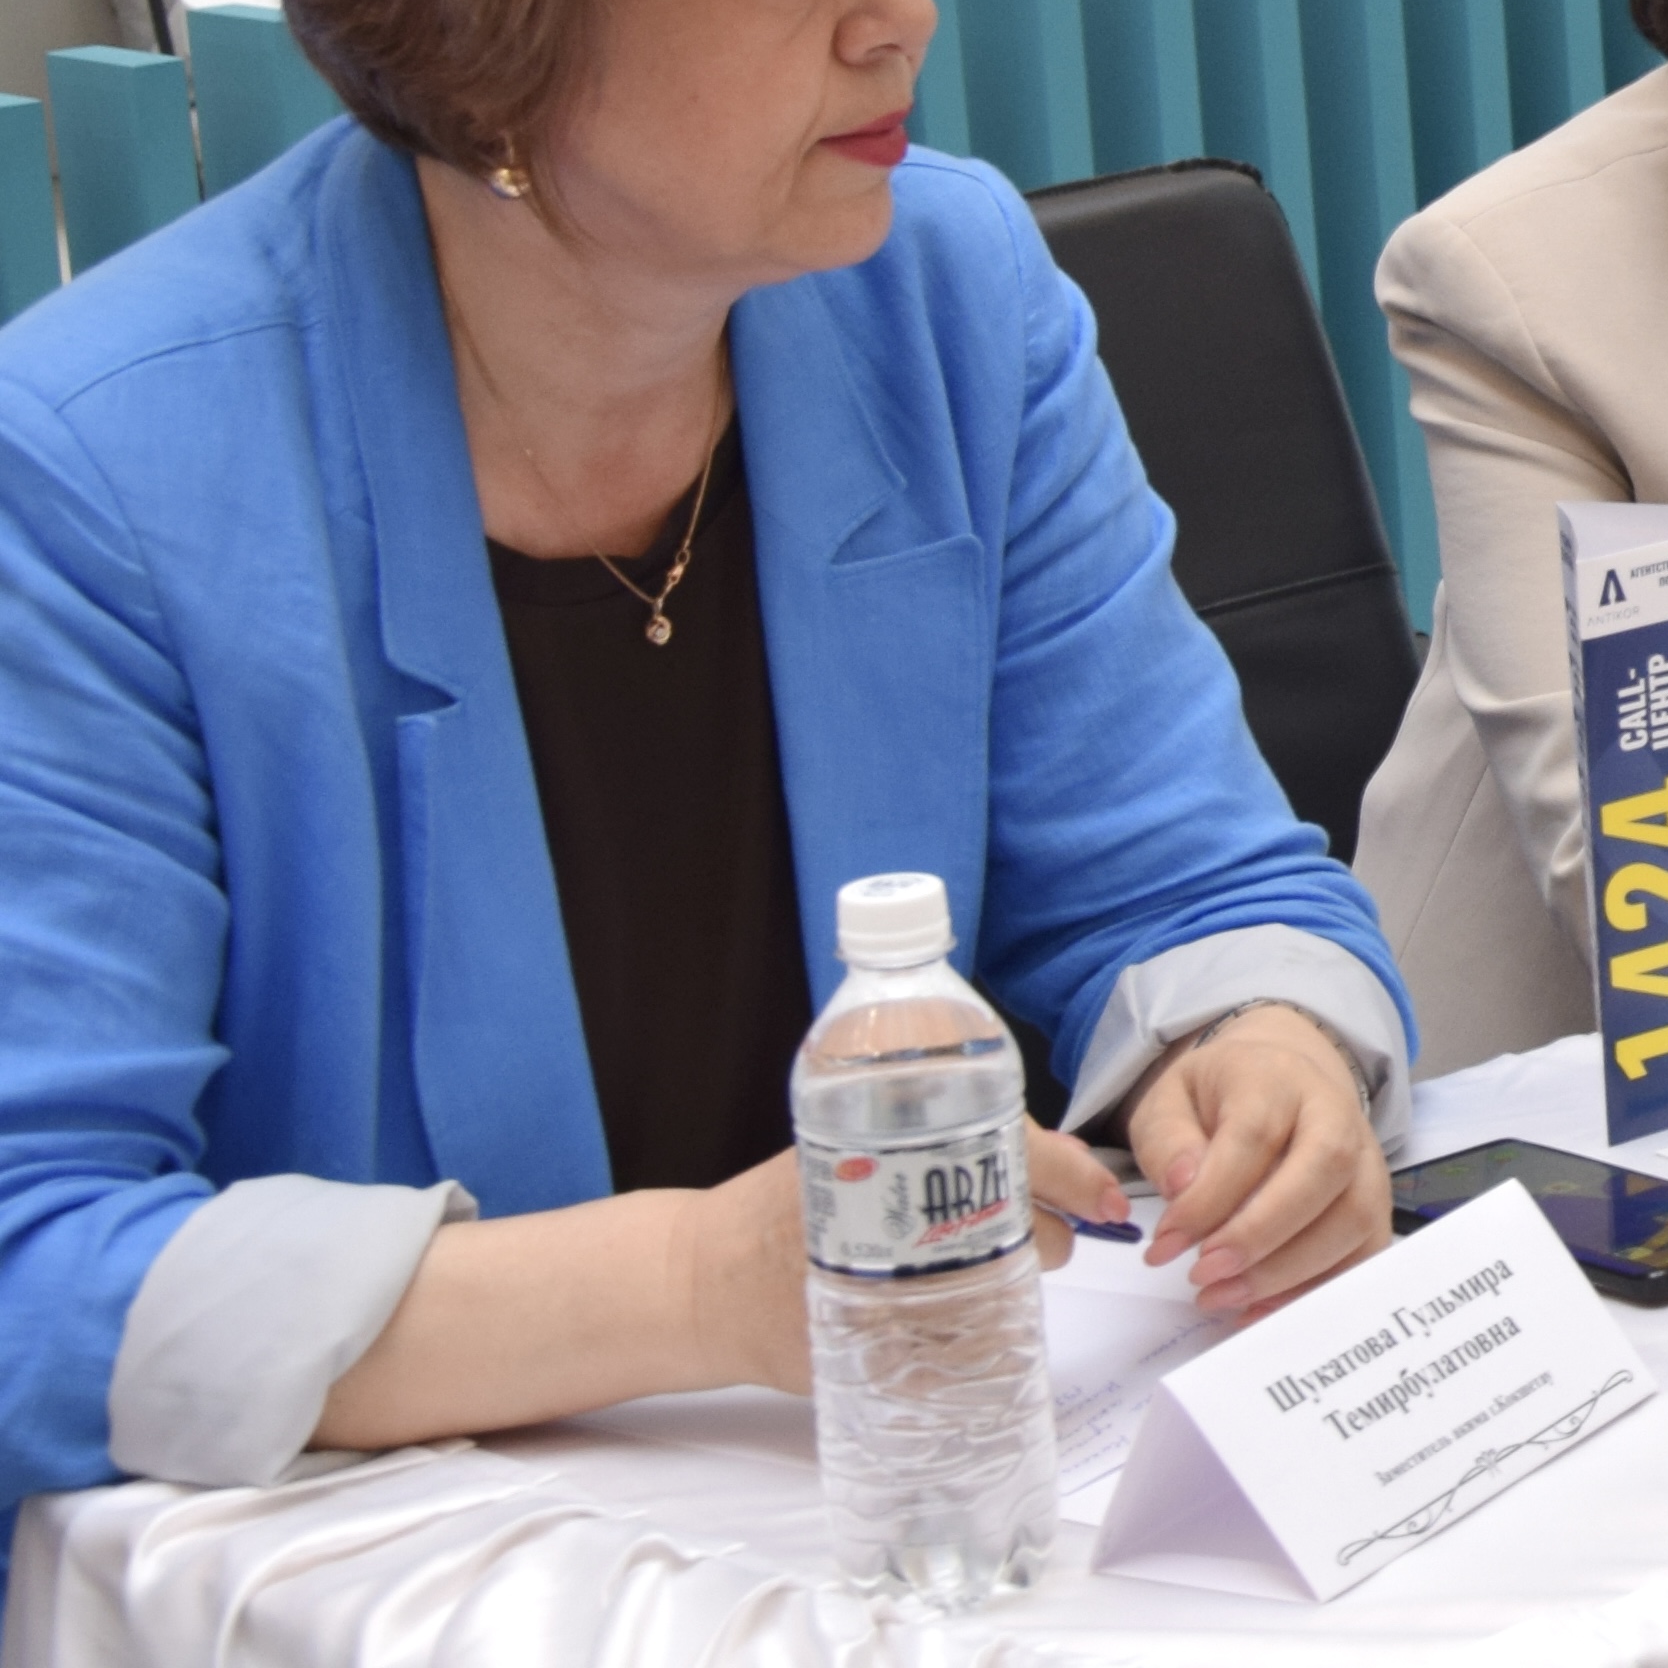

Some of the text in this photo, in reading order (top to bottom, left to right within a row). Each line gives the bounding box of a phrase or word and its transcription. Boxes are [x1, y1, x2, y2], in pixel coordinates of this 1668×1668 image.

[1619, 667, 1648, 752] CALL-
[1265, 1327, 1399, 1413] Шукатова
[1391, 1259, 1514, 1338] Гульмира
[1322, 1315, 1522, 1441] Темирбулатовна
